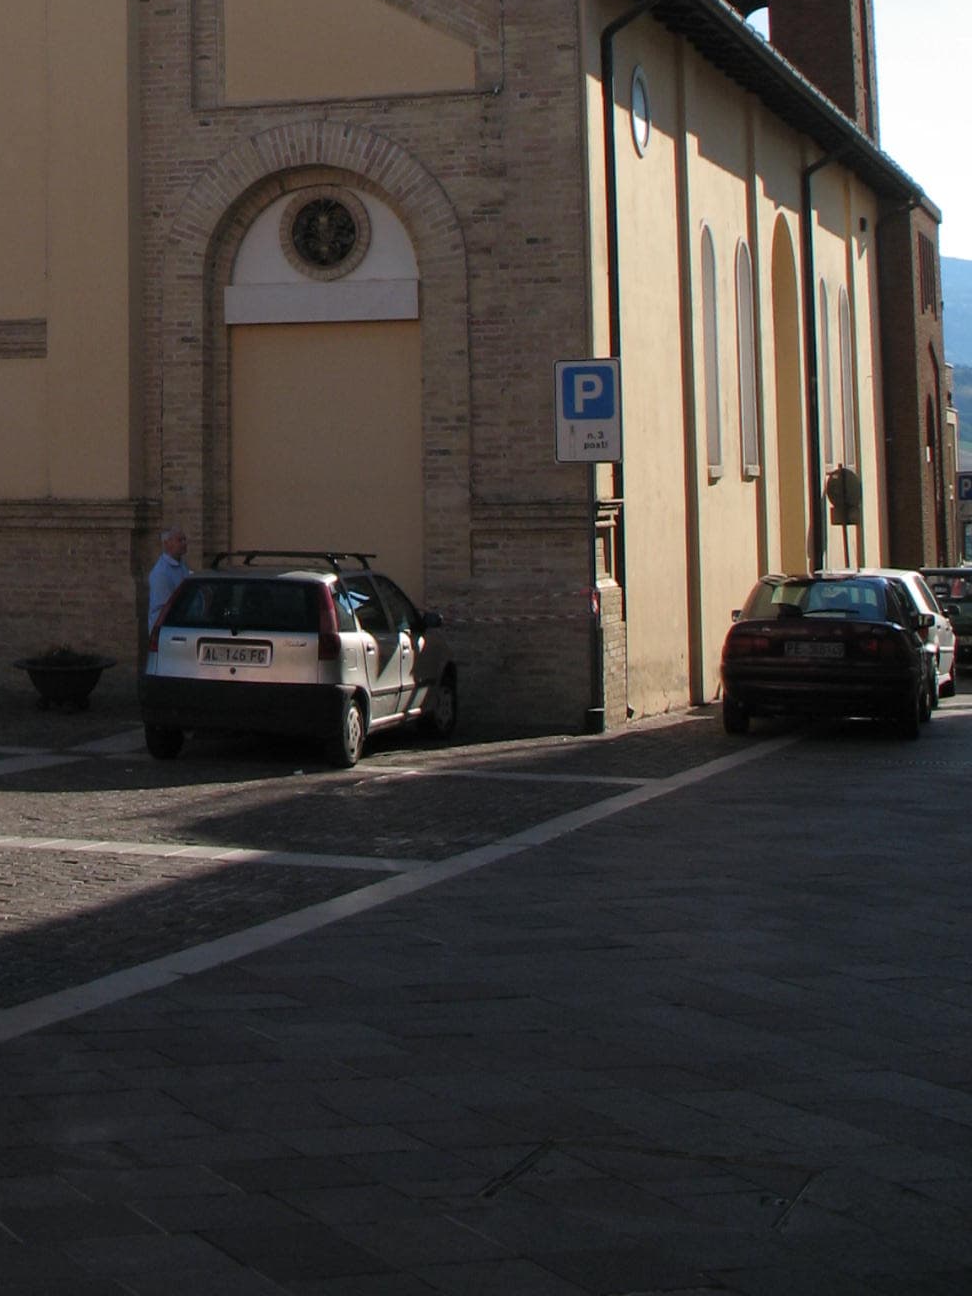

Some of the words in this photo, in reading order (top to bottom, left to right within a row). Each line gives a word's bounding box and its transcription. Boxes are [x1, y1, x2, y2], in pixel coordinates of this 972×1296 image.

[573, 373, 603, 413] P
[583, 440, 609, 451] posti
[961, 478, 971, 497] P
